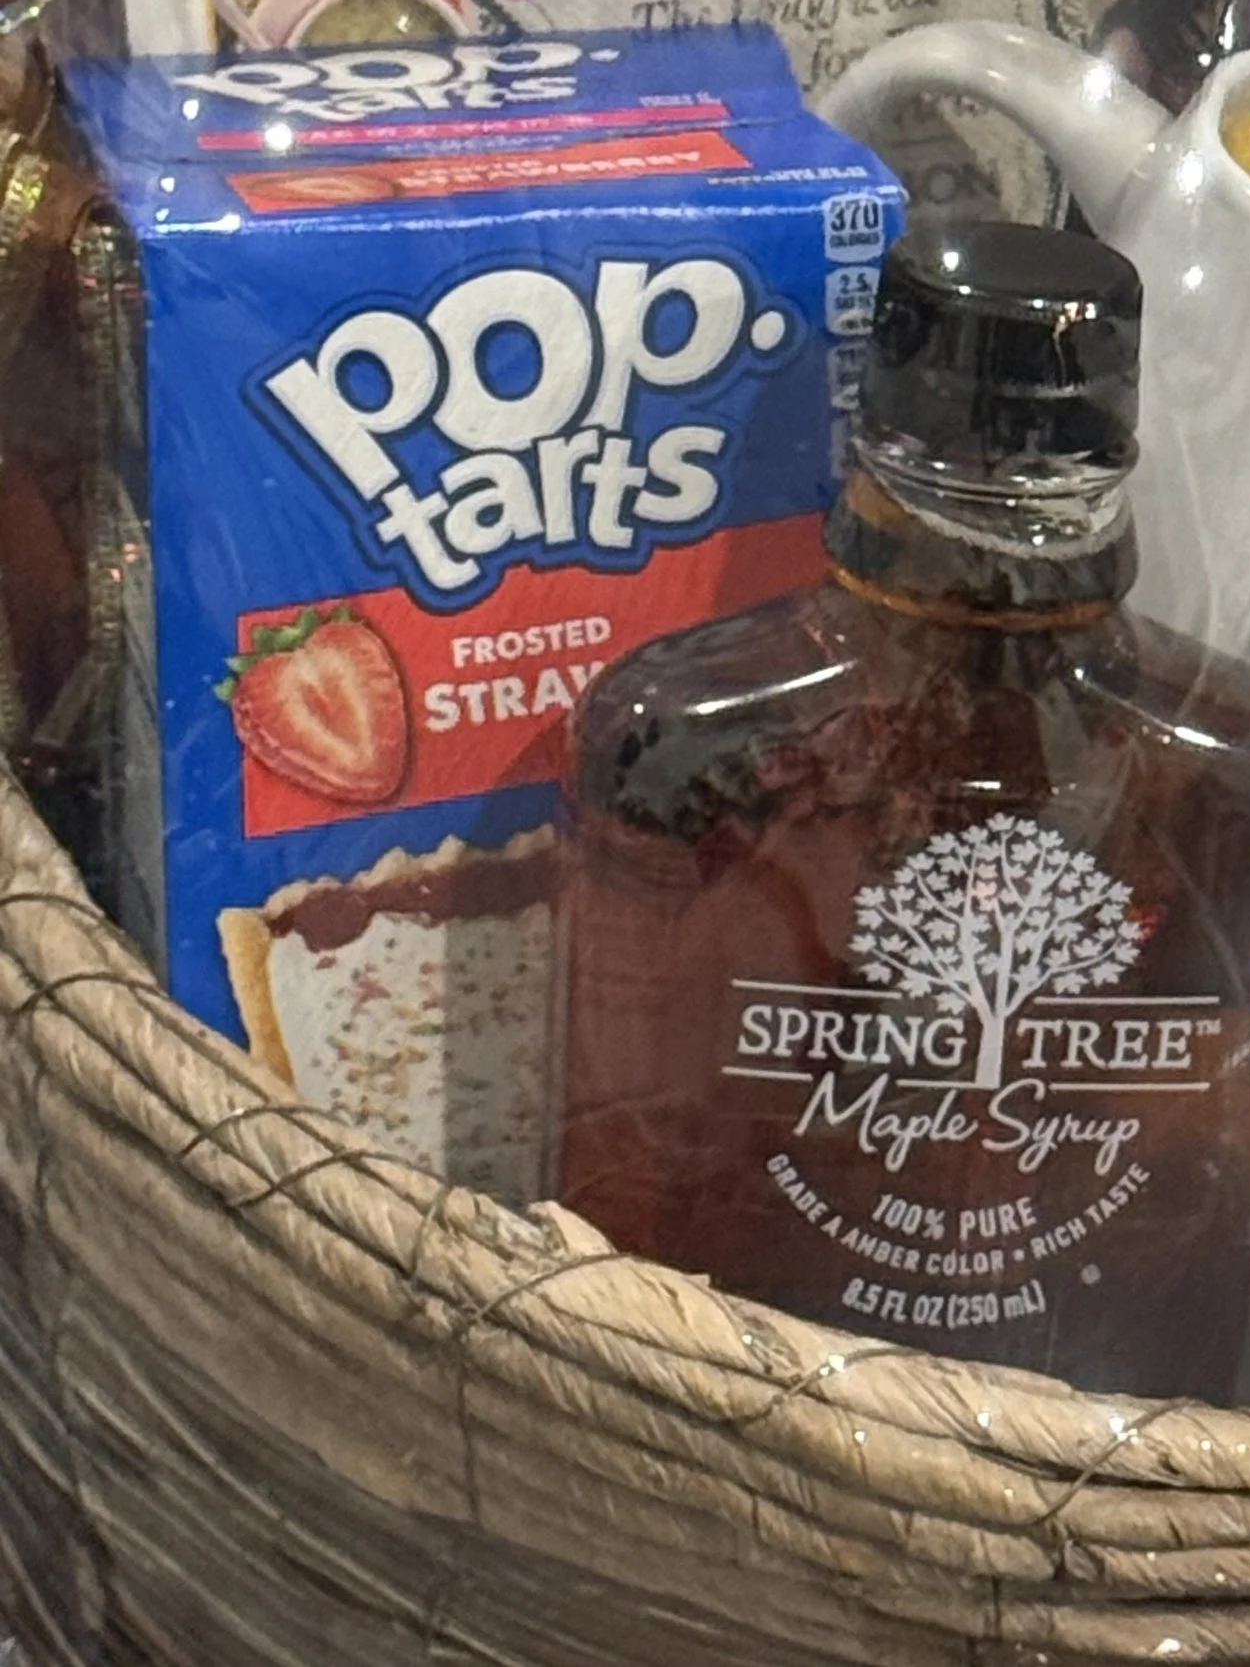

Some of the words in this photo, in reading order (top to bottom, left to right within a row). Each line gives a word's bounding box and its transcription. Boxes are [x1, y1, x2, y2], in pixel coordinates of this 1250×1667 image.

[829, 198, 880, 233] 370
[376, 425, 726, 590] tarts
[451, 615, 613, 669] FROSTED
[736, 1003, 968, 1068] SPRING
[793, 1073, 980, 1172] Maple
[981, 1077, 1141, 1177] Syrup
[766, 1151, 829, 1223] GRADE
[821, 1215, 844, 1238] A
[841, 1227, 920, 1273] AMBER
[925, 1248, 1005, 1277] COLOR
[1029, 1216, 1087, 1260] RICH
[1085, 1161, 1152, 1225] TASTE
[871, 1193, 946, 1241] 100%
[960, 1195, 1037, 1242] PURE
[841, 1277, 882, 1315] 8.5
[881, 1286, 908, 1323] FL
[912, 1291, 945, 1327] OZ
[944, 1289, 1000, 1330] (250
[1002, 1277, 1047, 1320] mL)
